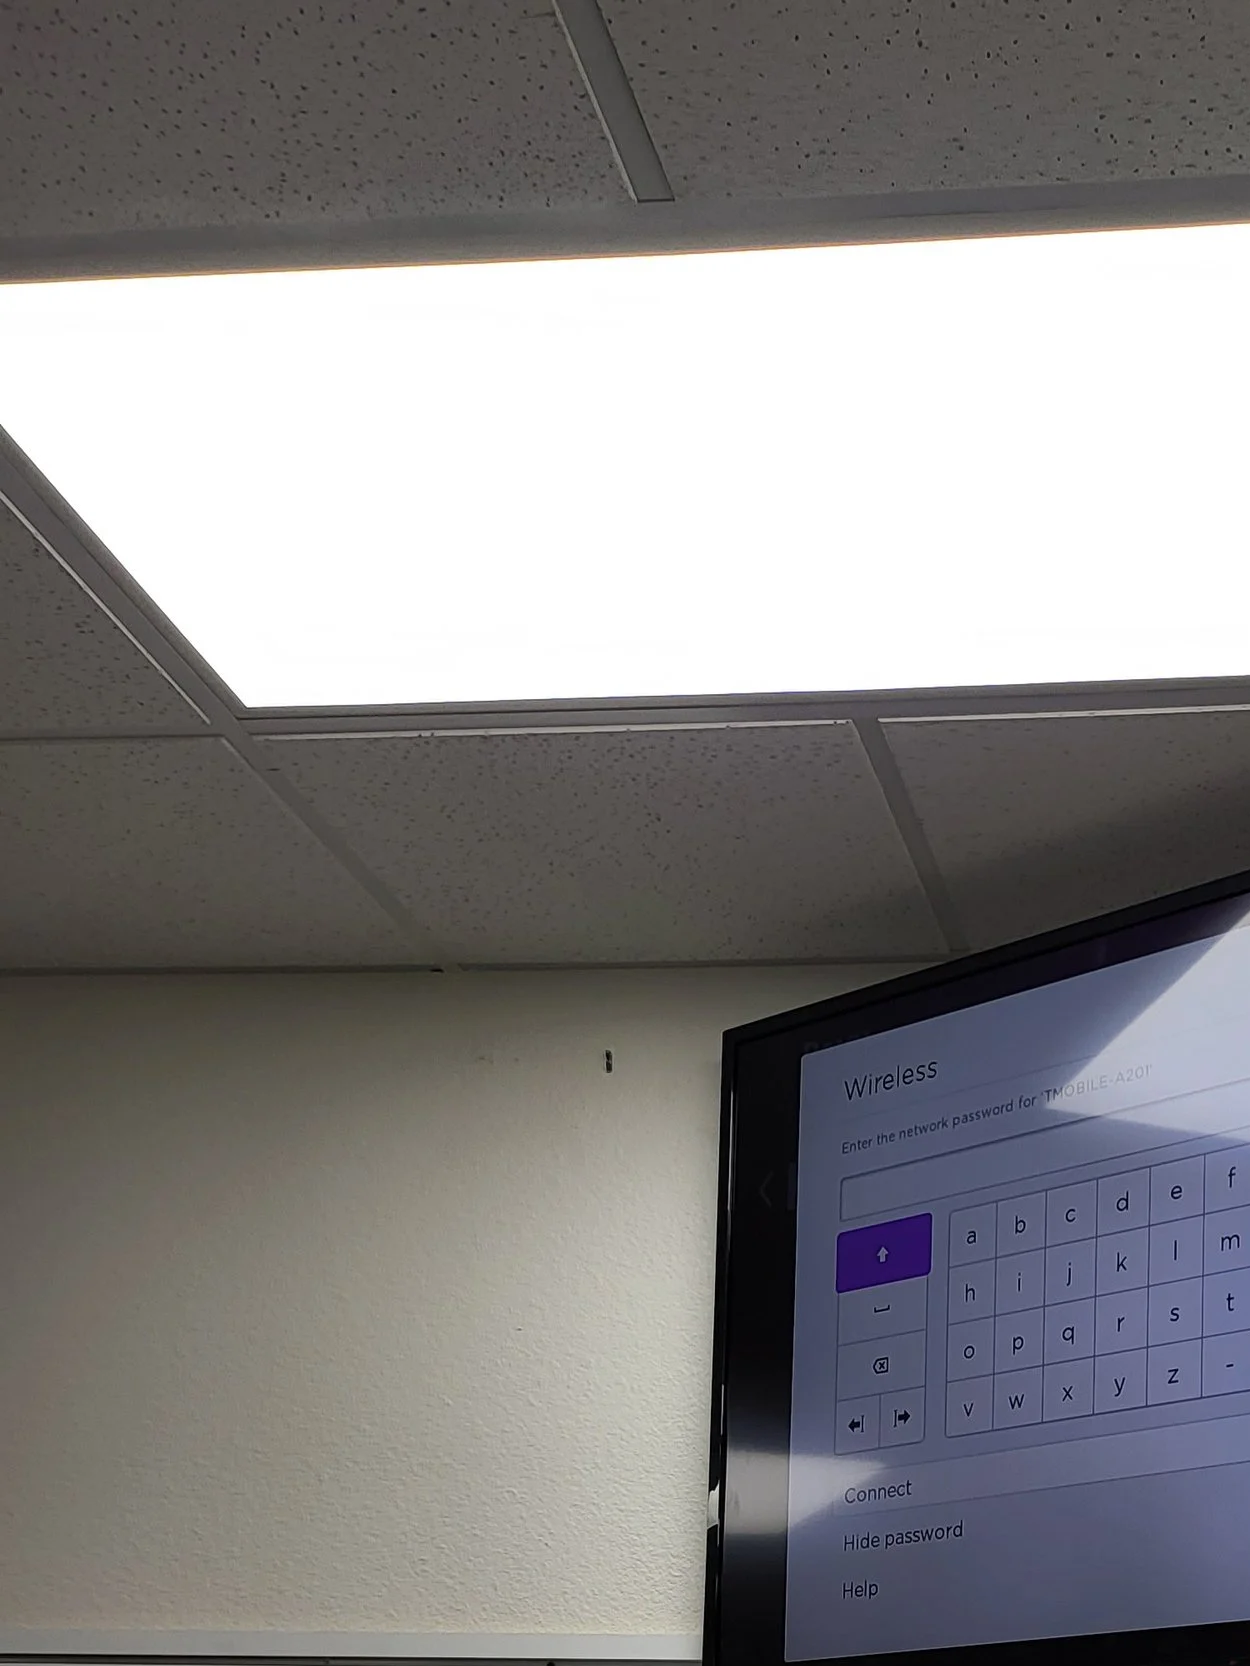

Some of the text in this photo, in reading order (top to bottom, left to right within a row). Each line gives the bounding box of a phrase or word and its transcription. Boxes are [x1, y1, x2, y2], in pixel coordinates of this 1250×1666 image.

[845, 1061, 938, 1101] Wireless
[842, 1138, 873, 1155] Enter
[876, 1132, 896, 1146] the
[899, 1117, 949, 1140] network
[952, 1099, 1014, 1128] password
[1018, 1095, 1037, 1109] for
[966, 1230, 977, 1245] a
[1014, 1215, 1027, 1235] b
[1065, 1208, 1076, 1223] c
[1116, 1190, 1129, 1212] d
[1170, 1185, 1183, 1200] e
[1227, 1166, 1237, 1189] f
[965, 1283, 976, 1303] h
[1116, 1251, 1128, 1273] k
[1220, 1234, 1240, 1252] m
[963, 1345, 975, 1359] o
[1012, 1336, 1024, 1356] p
[1062, 1326, 1075, 1345] q
[1117, 1316, 1125, 1333] r
[1169, 1307, 1180, 1322] s
[1226, 1292, 1235, 1312] t
[963, 1402, 974, 1417] v
[1008, 1393, 1025, 1410] w
[1062, 1385, 1073, 1402] x
[1114, 1376, 1126, 1397] y
[1167, 1368, 1179, 1385] z
[844, 1480, 912, 1504] Connect
[843, 1520, 963, 1552] Hide password
[842, 1580, 879, 1599] Help
